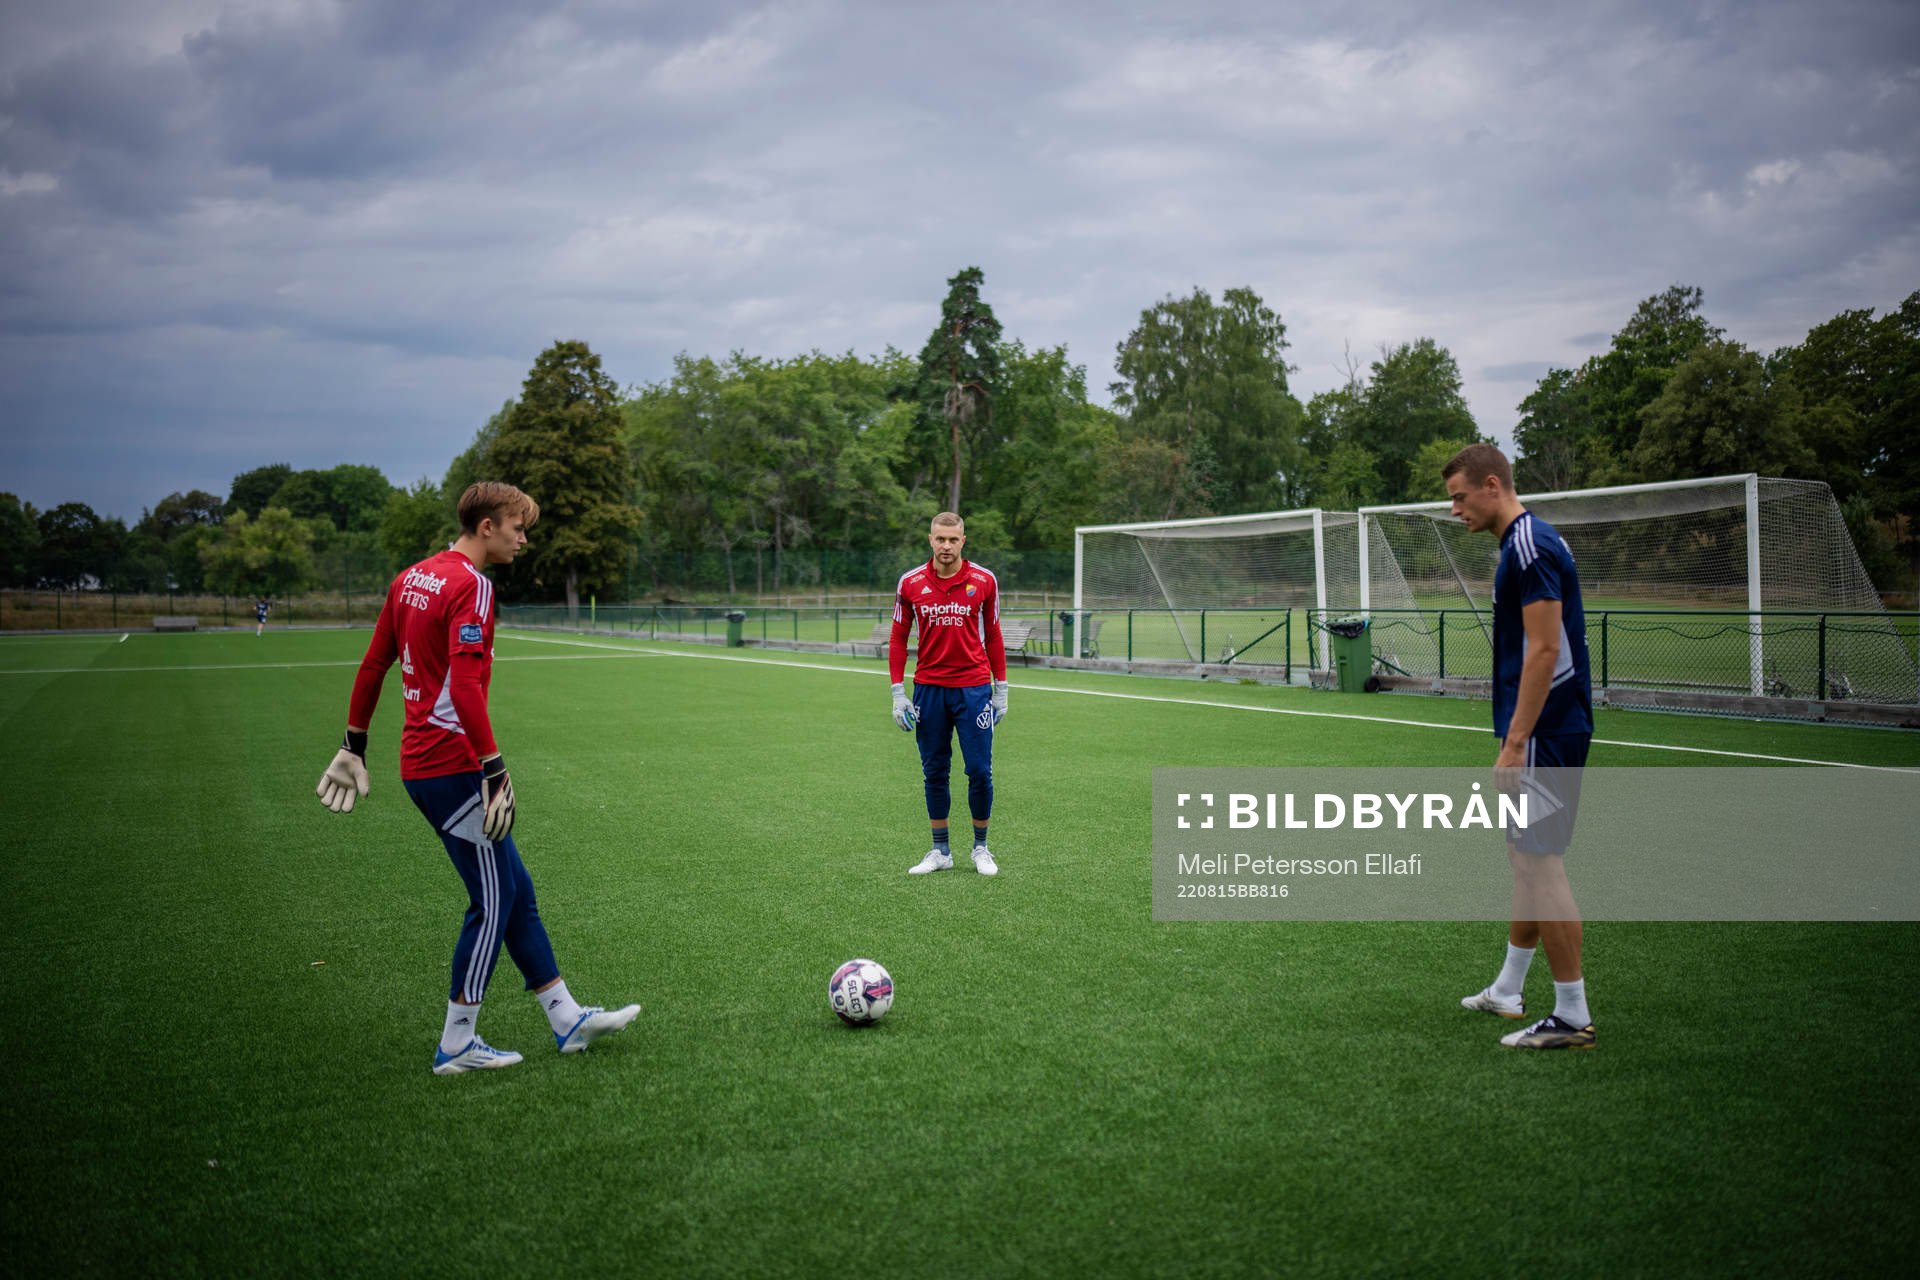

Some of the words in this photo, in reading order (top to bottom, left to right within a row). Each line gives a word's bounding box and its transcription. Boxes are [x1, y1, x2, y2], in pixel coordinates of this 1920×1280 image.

[403, 568, 447, 595] Prioritet
[920, 602, 972, 617] Prioritet
[929, 615, 964, 627] Finans
[847, 980, 863, 1014] SELECT
